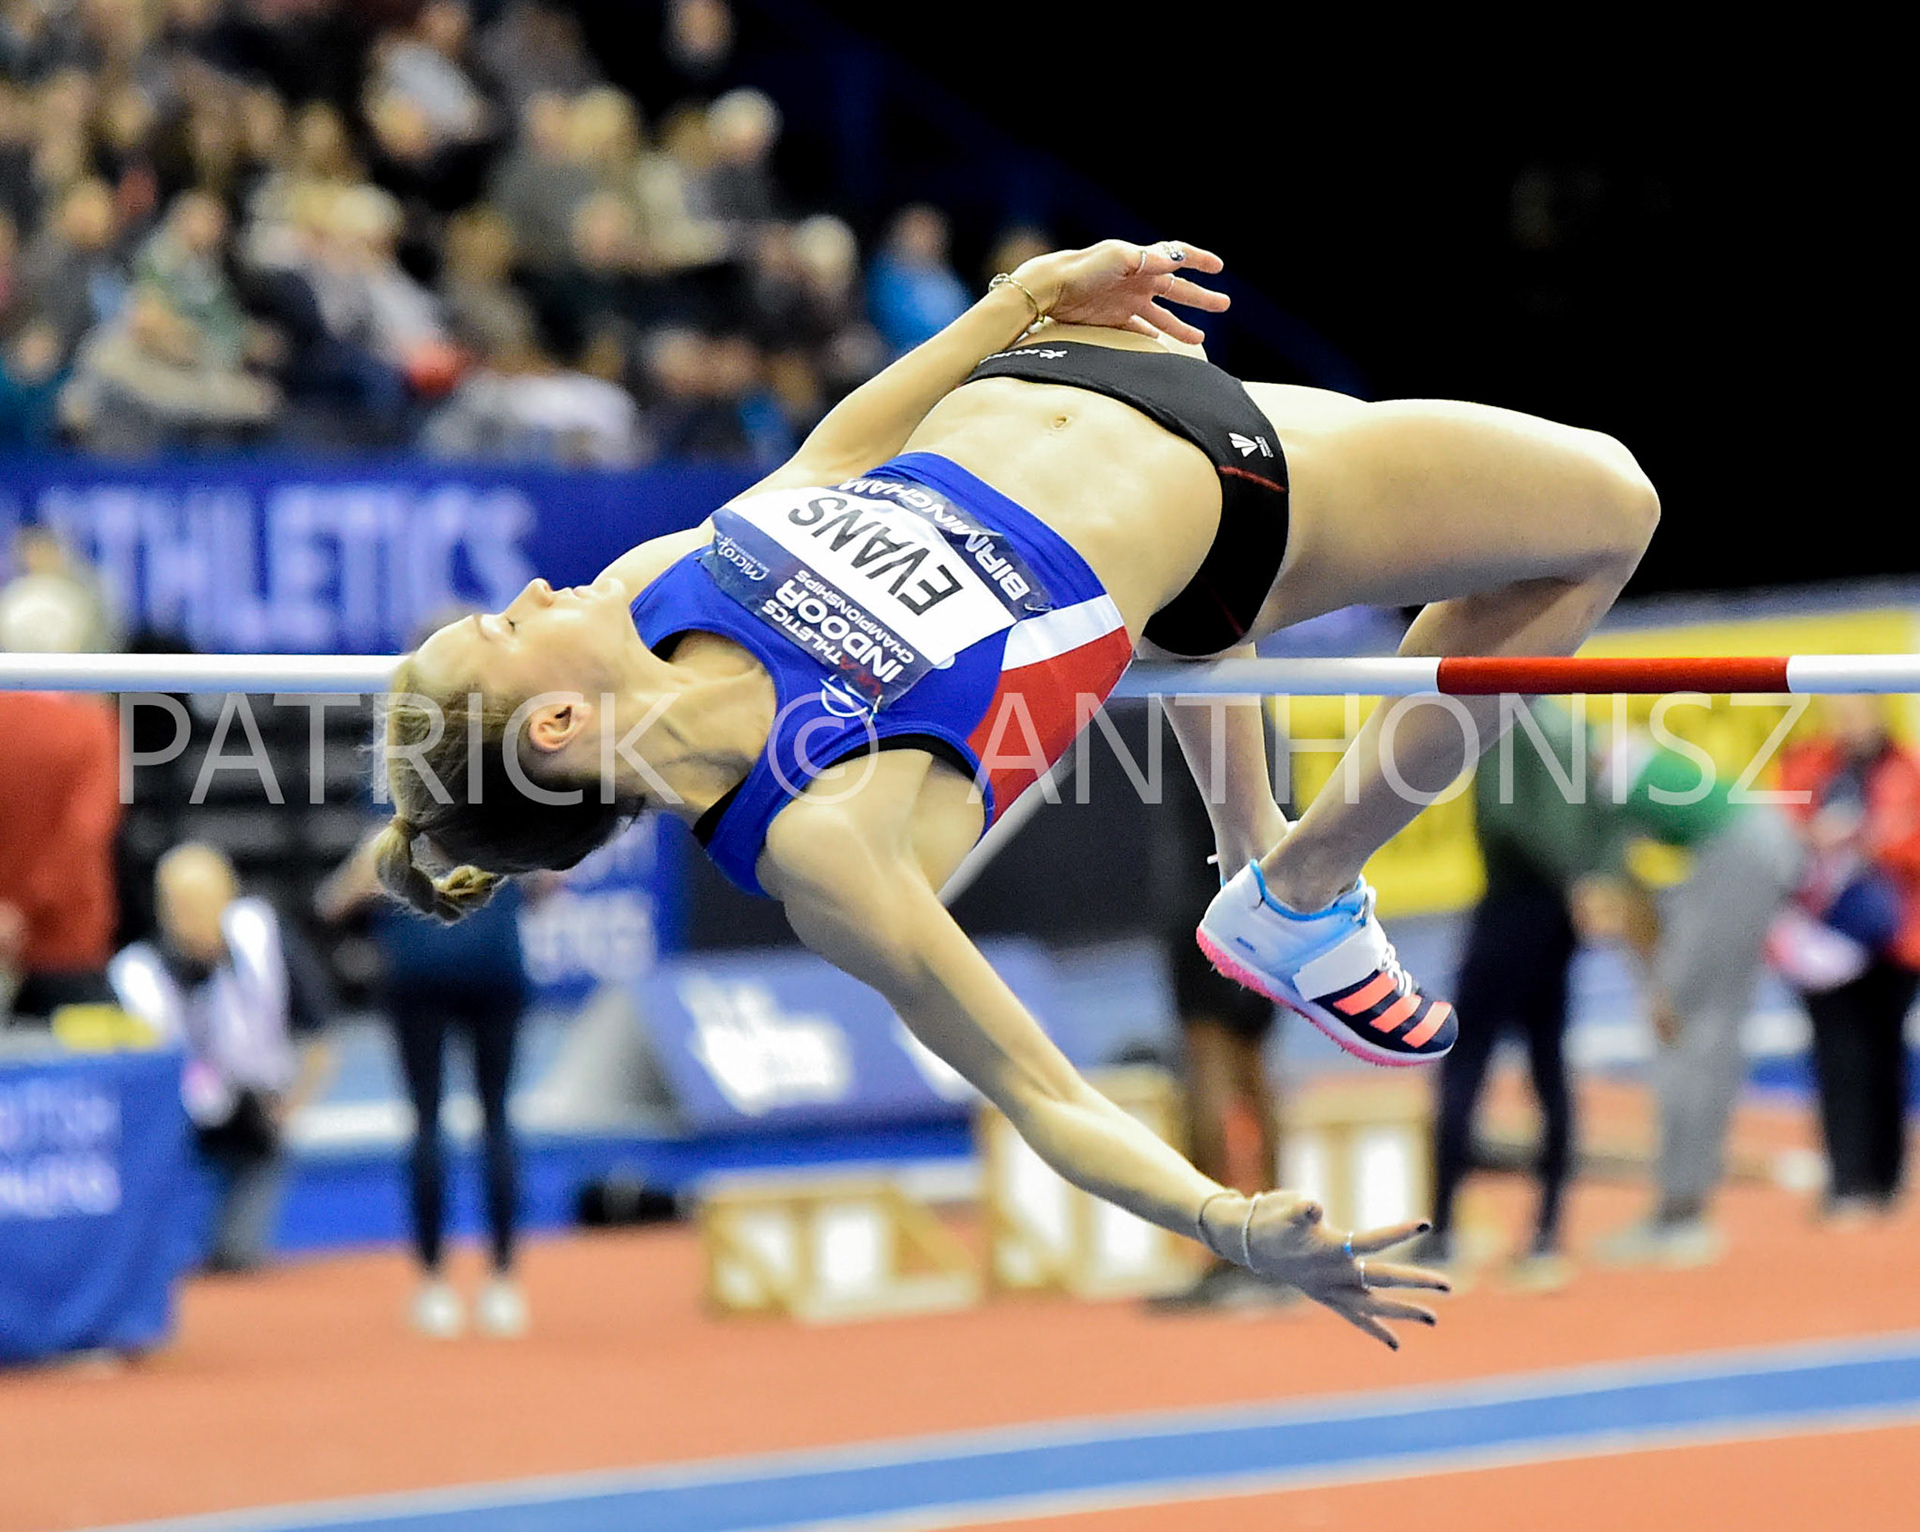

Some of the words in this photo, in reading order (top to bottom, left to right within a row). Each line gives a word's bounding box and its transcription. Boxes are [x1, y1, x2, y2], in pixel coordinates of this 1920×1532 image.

[788, 496, 964, 616] EVANS
[838, 478, 1030, 601] BIRMINGHAM
[761, 599, 857, 670] ATHLETICS
[775, 578, 904, 683] INDOOR
[794, 569, 915, 664] CHAMPIONSHIPS
